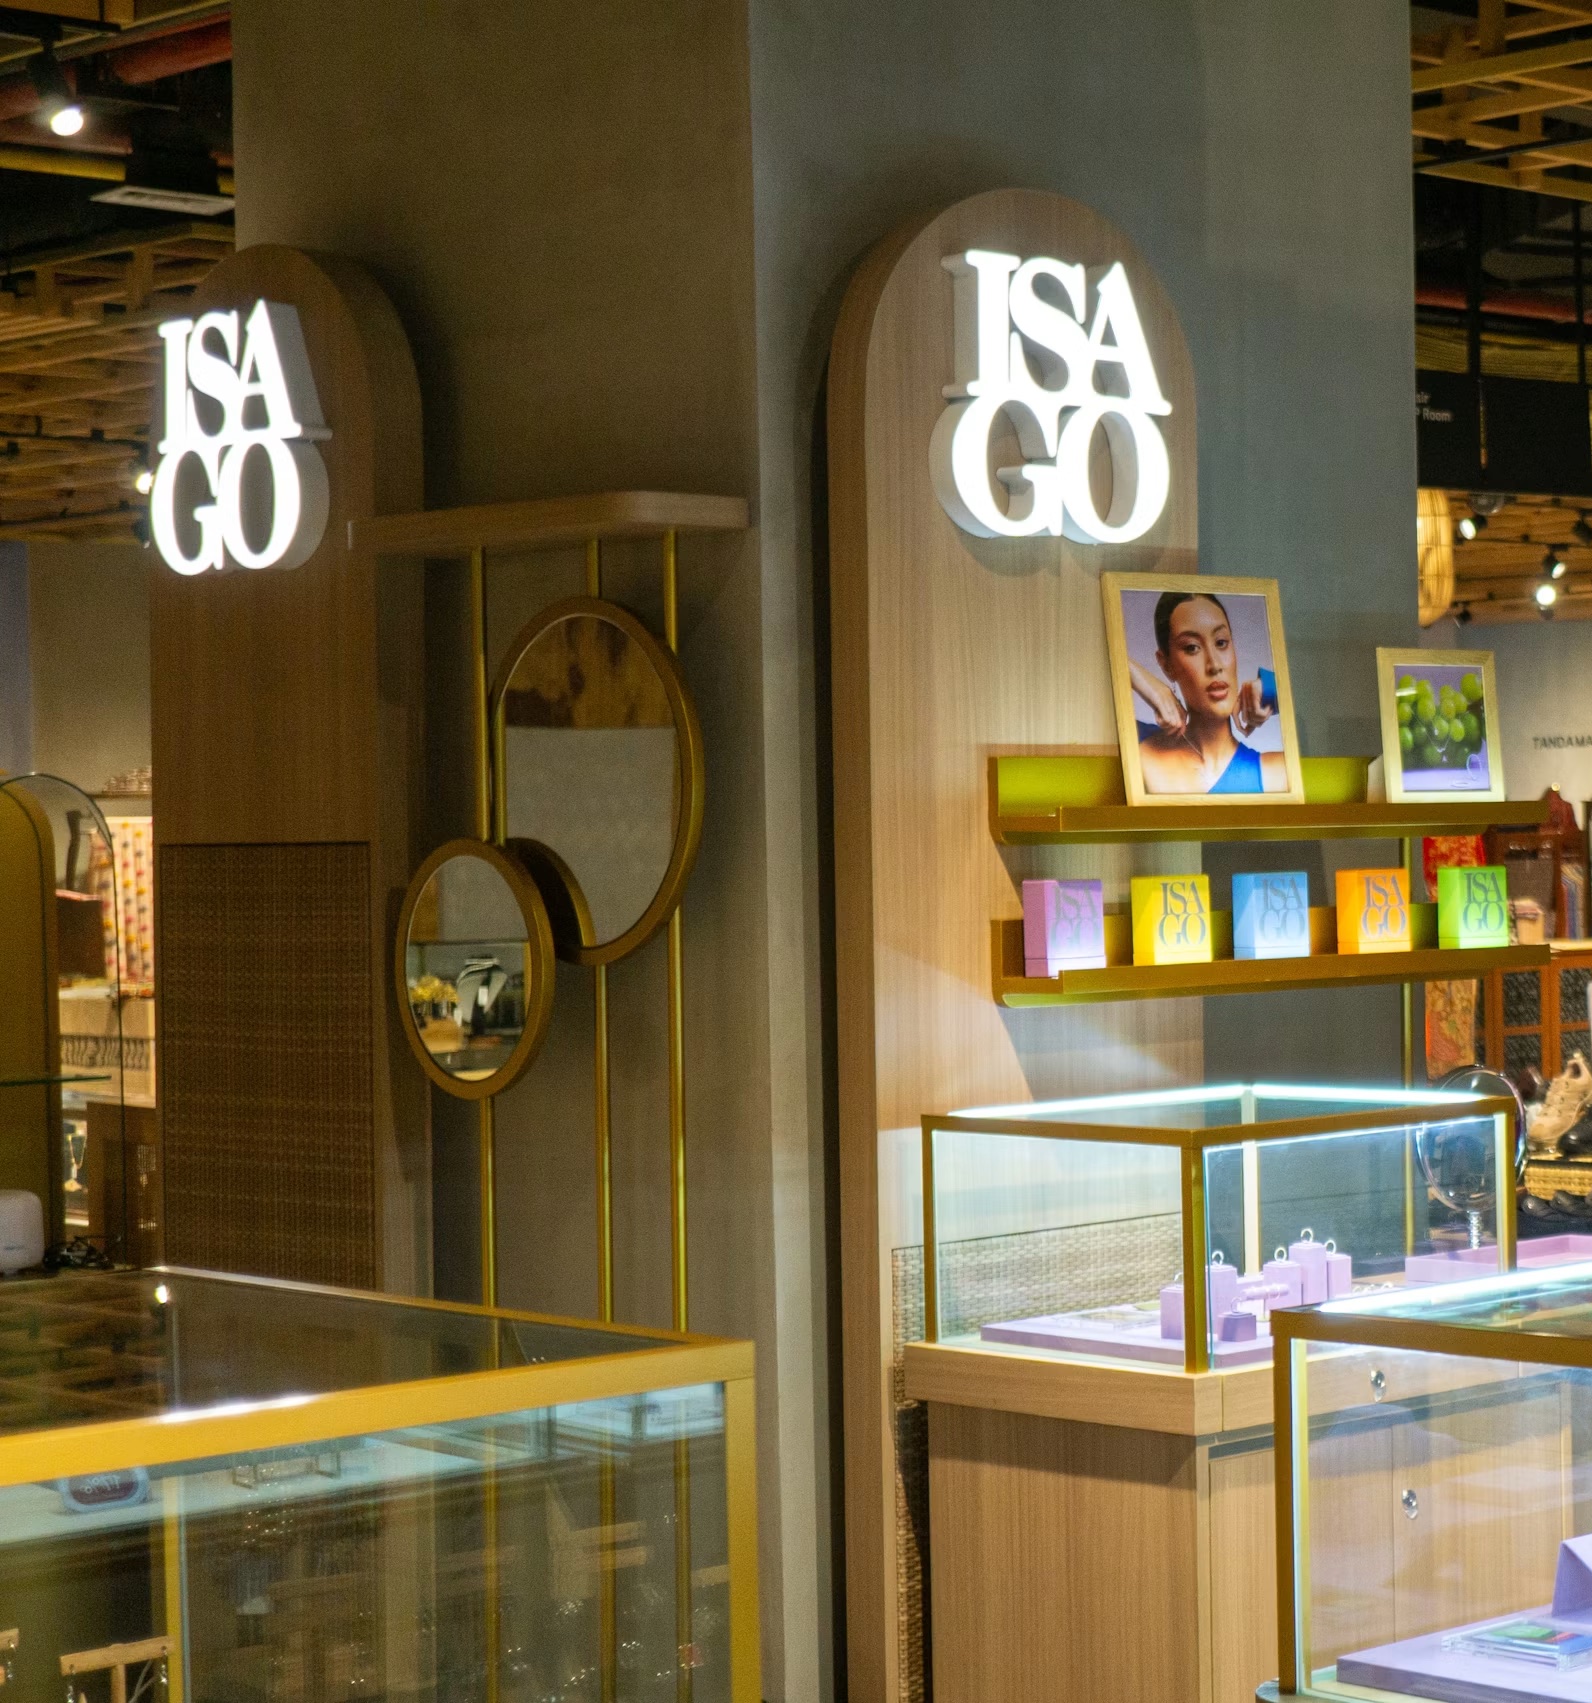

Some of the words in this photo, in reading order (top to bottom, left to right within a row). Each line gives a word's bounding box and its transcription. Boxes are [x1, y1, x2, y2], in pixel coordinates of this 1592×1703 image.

[965, 250, 1172, 416] ISA
[158, 298, 303, 455] ISA
[1423, 408, 1452, 422] Room
[951, 396, 1170, 544] GO
[151, 439, 301, 577] GO
[1054, 884, 1100, 921] ISA
[1160, 881, 1206, 915] ISA
[1262, 875, 1304, 909] ISA
[1363, 874, 1405, 907] ISA
[1463, 871, 1505, 903] ISA
[1052, 917, 1101, 949] GO
[1158, 913, 1207, 945] GO
[1259, 908, 1306, 941] GO
[1361, 905, 1407, 939] GO
[1462, 901, 1505, 933] GO
